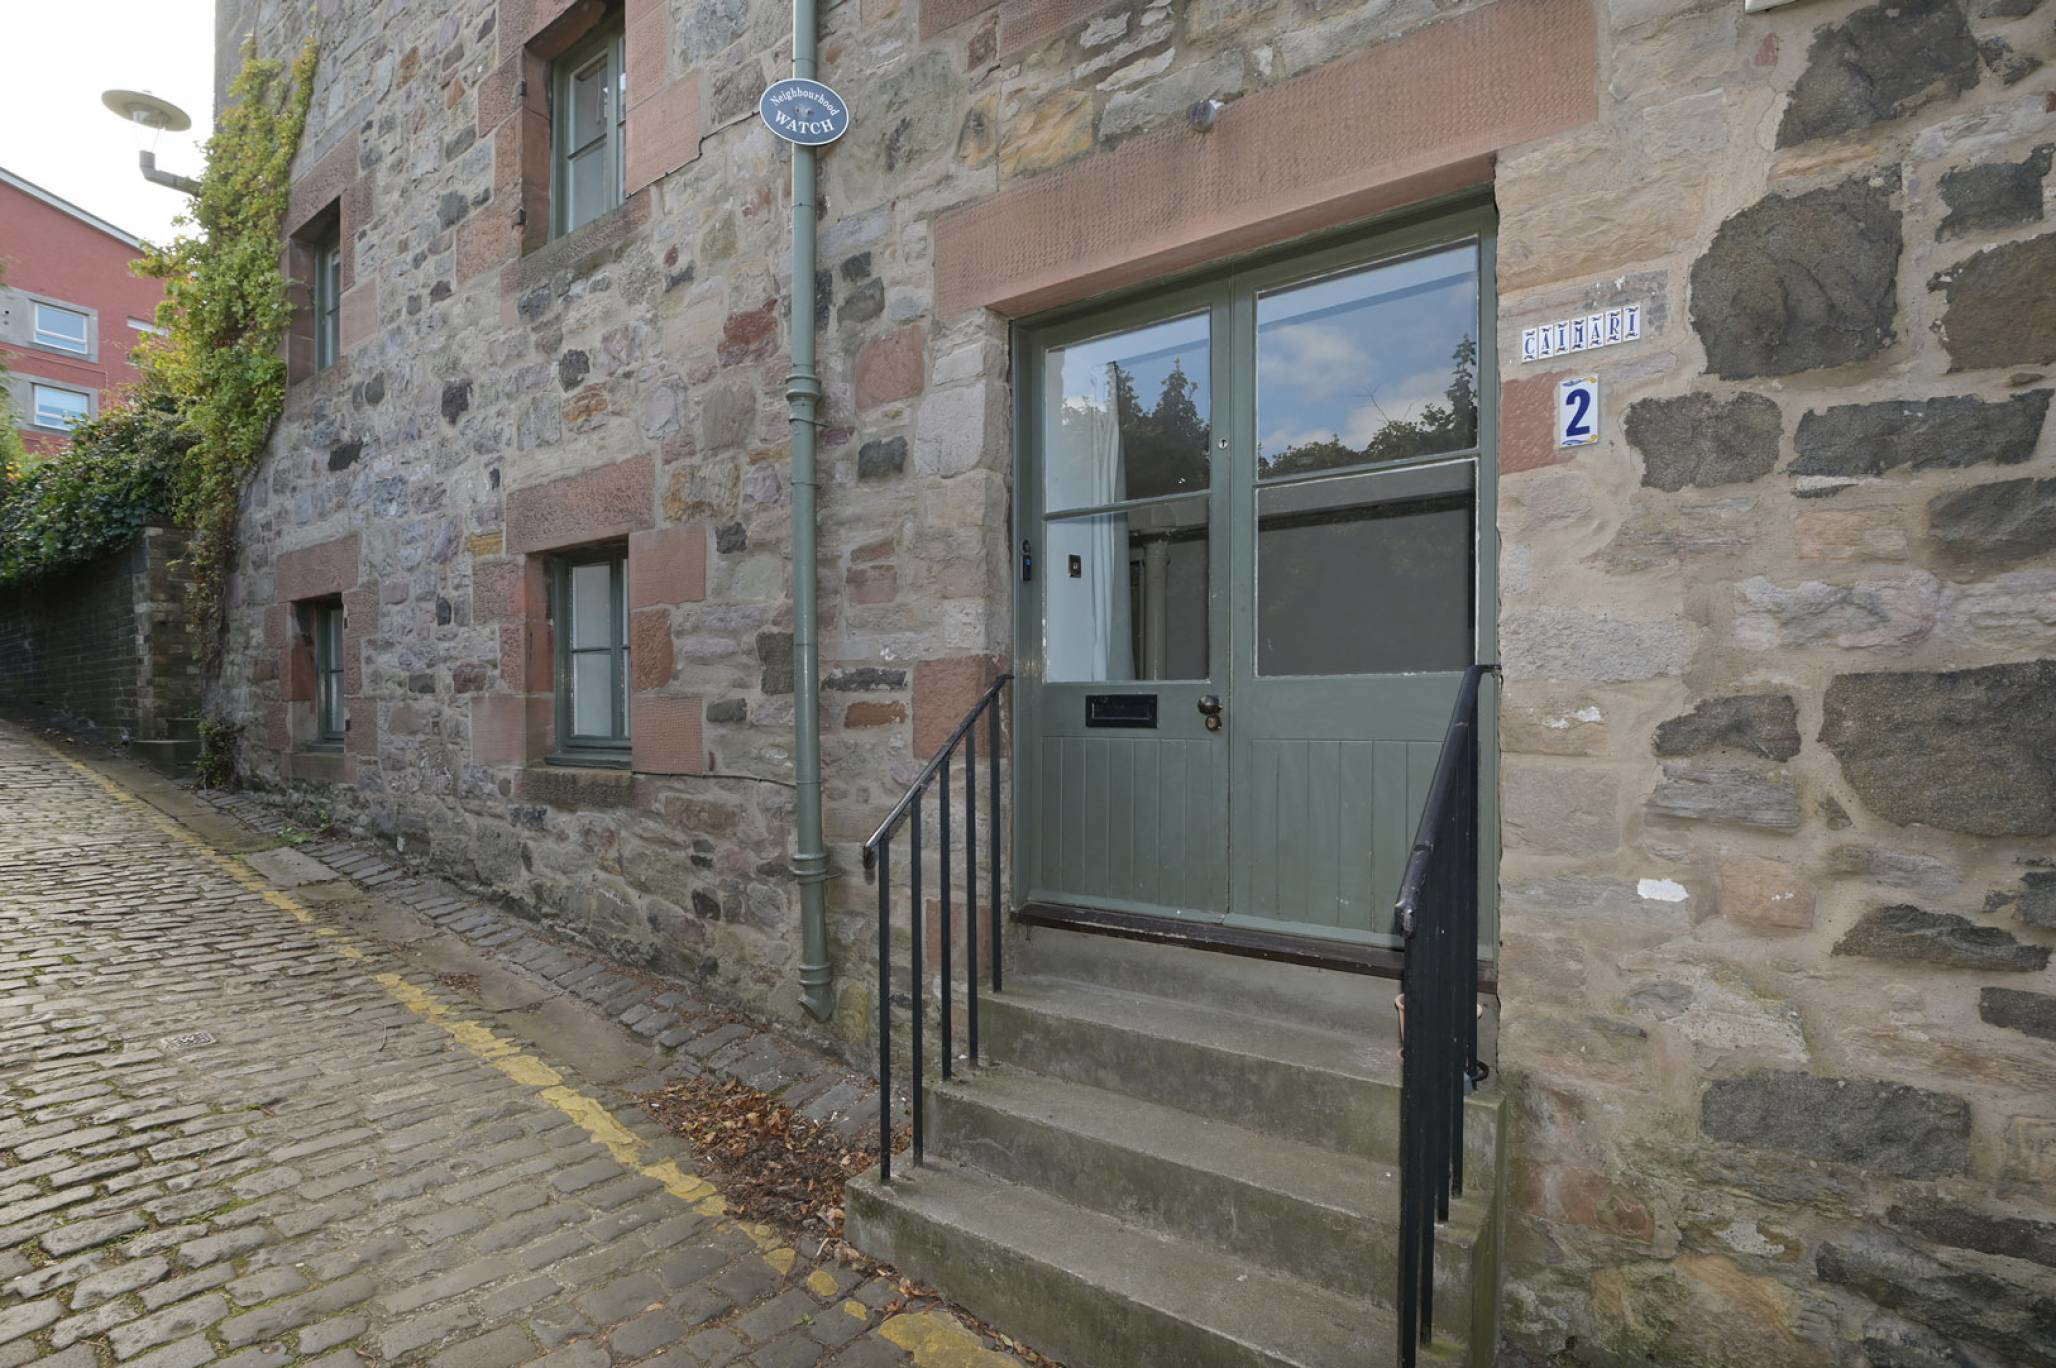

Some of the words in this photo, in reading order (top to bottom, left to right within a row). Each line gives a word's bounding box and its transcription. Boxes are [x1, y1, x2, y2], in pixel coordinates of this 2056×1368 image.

[770, 87, 840, 116] Neighbourhood
[775, 110, 835, 135] WATCH
[1524, 311, 1635, 356] CAIMARI
[1566, 388, 1591, 437] 2
